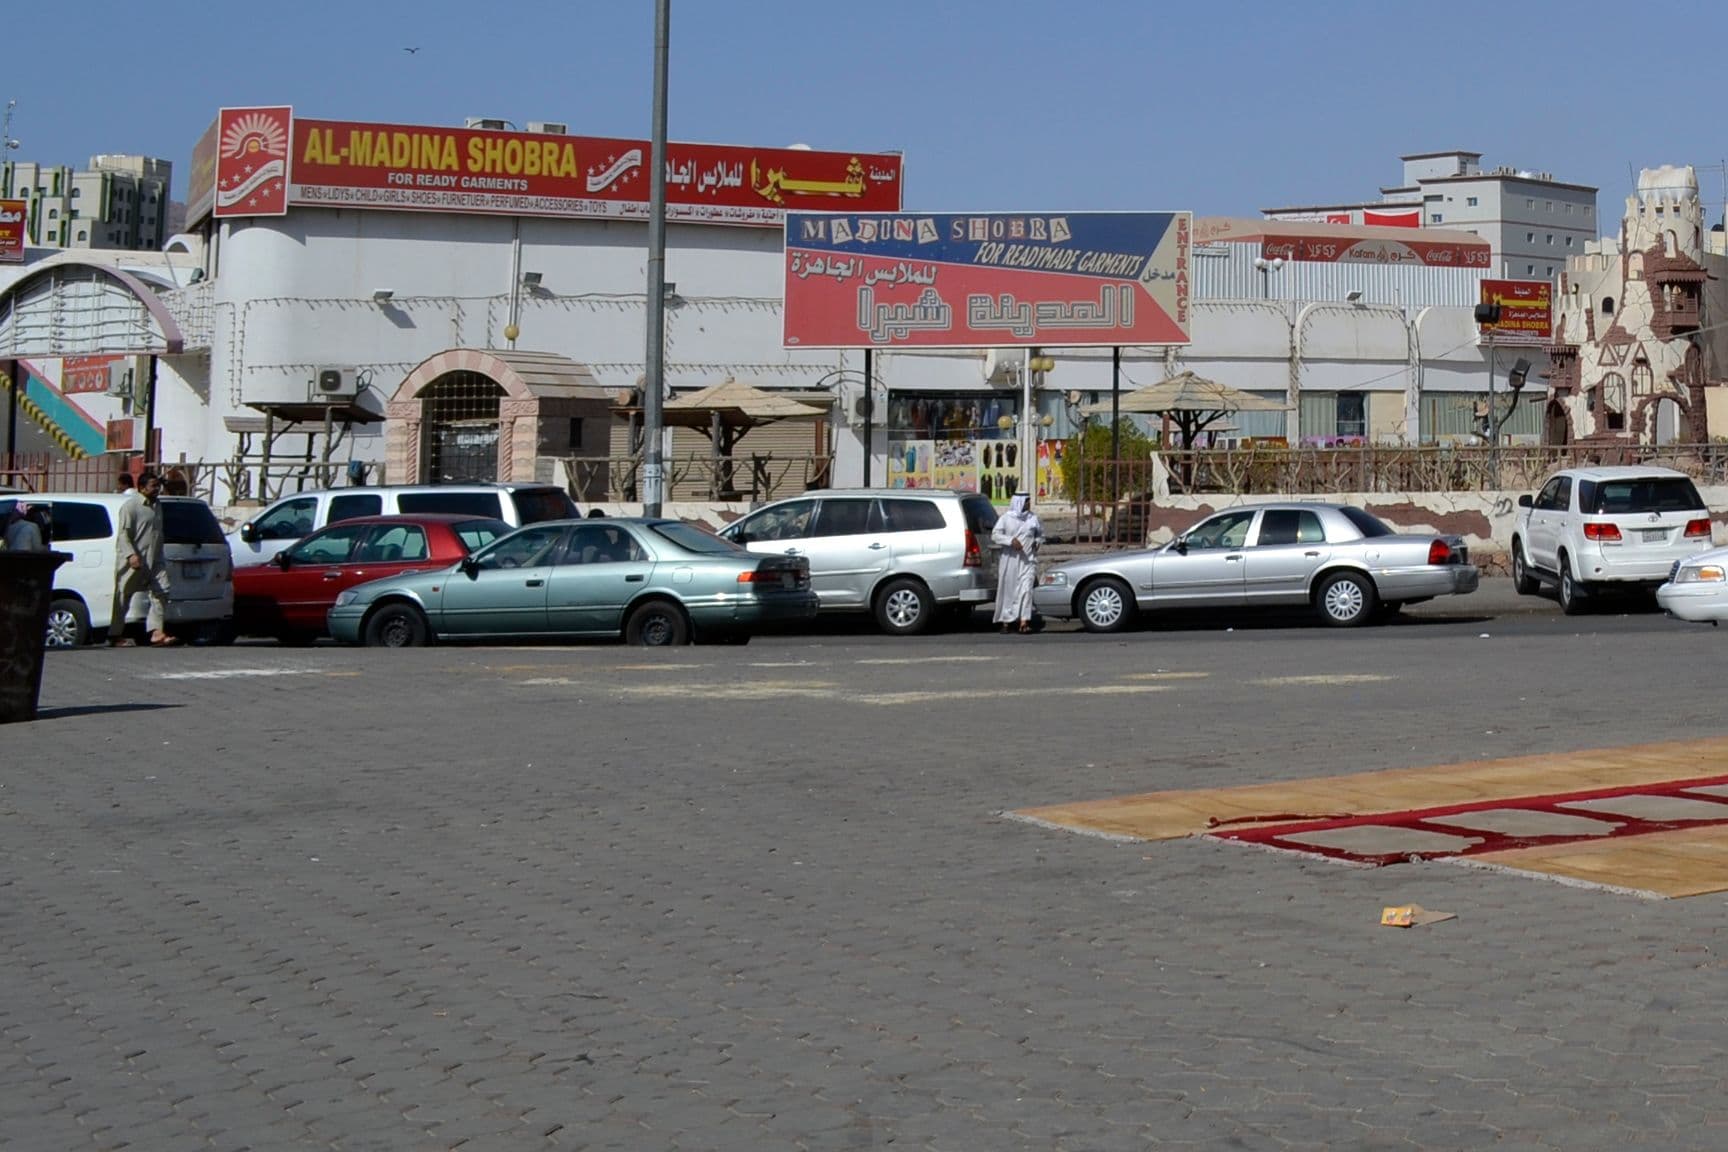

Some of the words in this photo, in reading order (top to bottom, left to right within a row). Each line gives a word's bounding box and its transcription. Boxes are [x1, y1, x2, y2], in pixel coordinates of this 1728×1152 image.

[303, 128, 460, 171] AL-MADINA
[467, 136, 578, 178] SHOBRA
[388, 172, 413, 186] FOR
[416, 174, 458, 188] READY
[460, 176, 528, 191] GARMENTS
[665, 157, 697, 191] الجاه
[697, 161, 743, 195] للملابس
[300, 186, 322, 200] MENS
[355, 189, 378, 202] CHILD
[383, 190, 406, 203] GIRLS
[411, 191, 436, 205] SHOES
[589, 200, 607, 214] TOYS
[801, 219, 940, 245] MADINA
[951, 216, 1071, 243] SHOBRA
[791, 252, 863, 282] الجاهزة
[974, 241, 1003, 264] FOR
[1002, 244, 1077, 271] READYMADE
[1078, 251, 1145, 276] GARMENTS
[1349, 248, 1376, 260] Karam
[1390, 250, 1416, 262] كرم
[865, 262, 937, 289] للملابس
[1142, 268, 1176, 283] مدخل
[1176, 218, 1189, 323] ENTRANCE
[857, 285, 953, 343] شبرا
[967, 284, 1135, 338] المدينة
